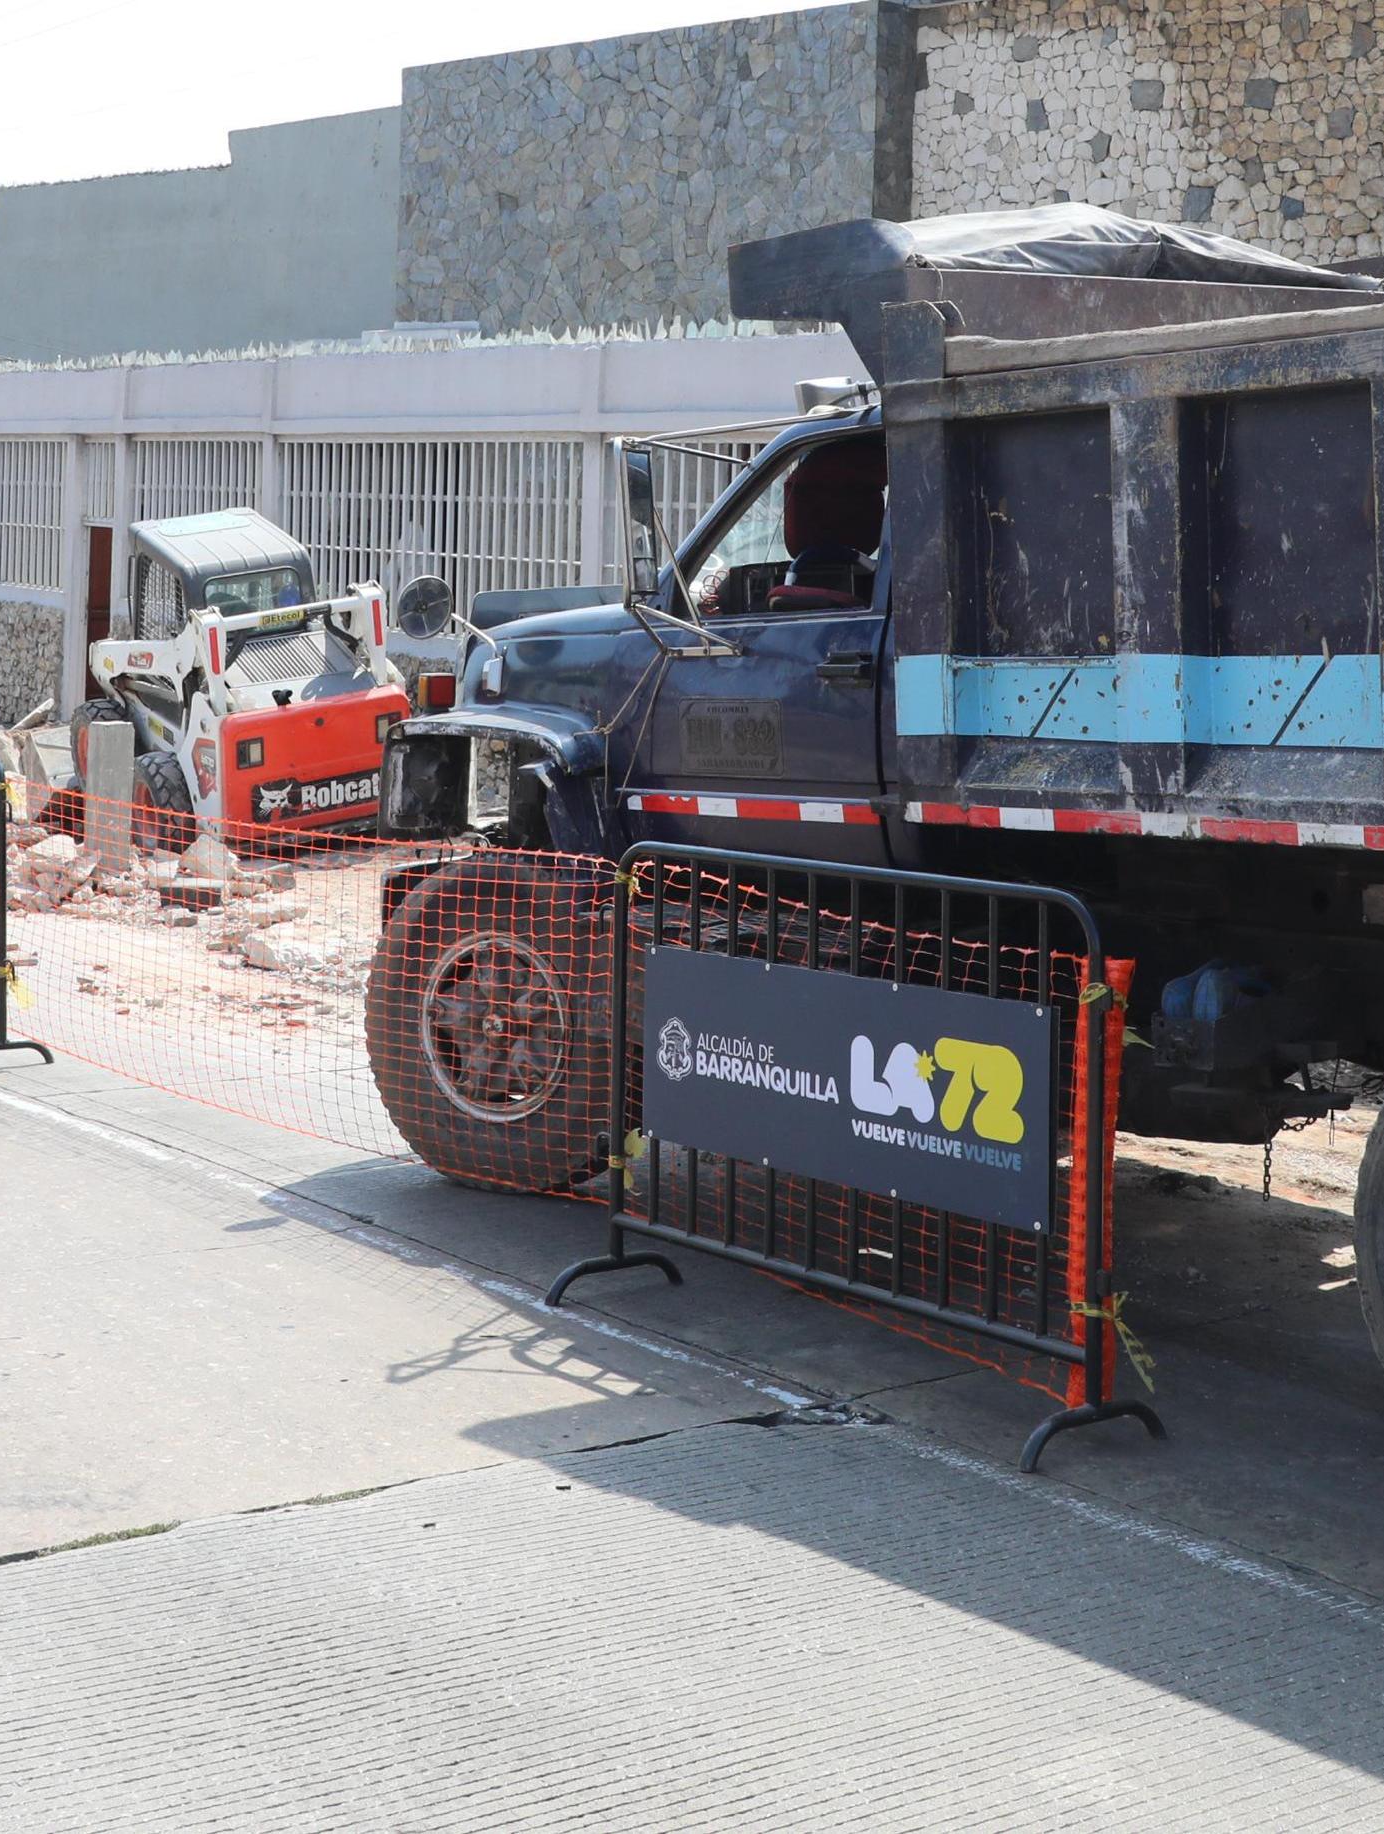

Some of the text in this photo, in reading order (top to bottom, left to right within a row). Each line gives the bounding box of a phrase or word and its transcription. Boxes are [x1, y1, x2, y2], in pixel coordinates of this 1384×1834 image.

[301, 772, 380, 811] Bobcat
[697, 1032, 775, 1064] ALCALDÍA DE
[695, 1049, 840, 1105] BARRANQUILLA
[851, 1118, 1022, 1172] VUELVE VUELVE VUELVE
